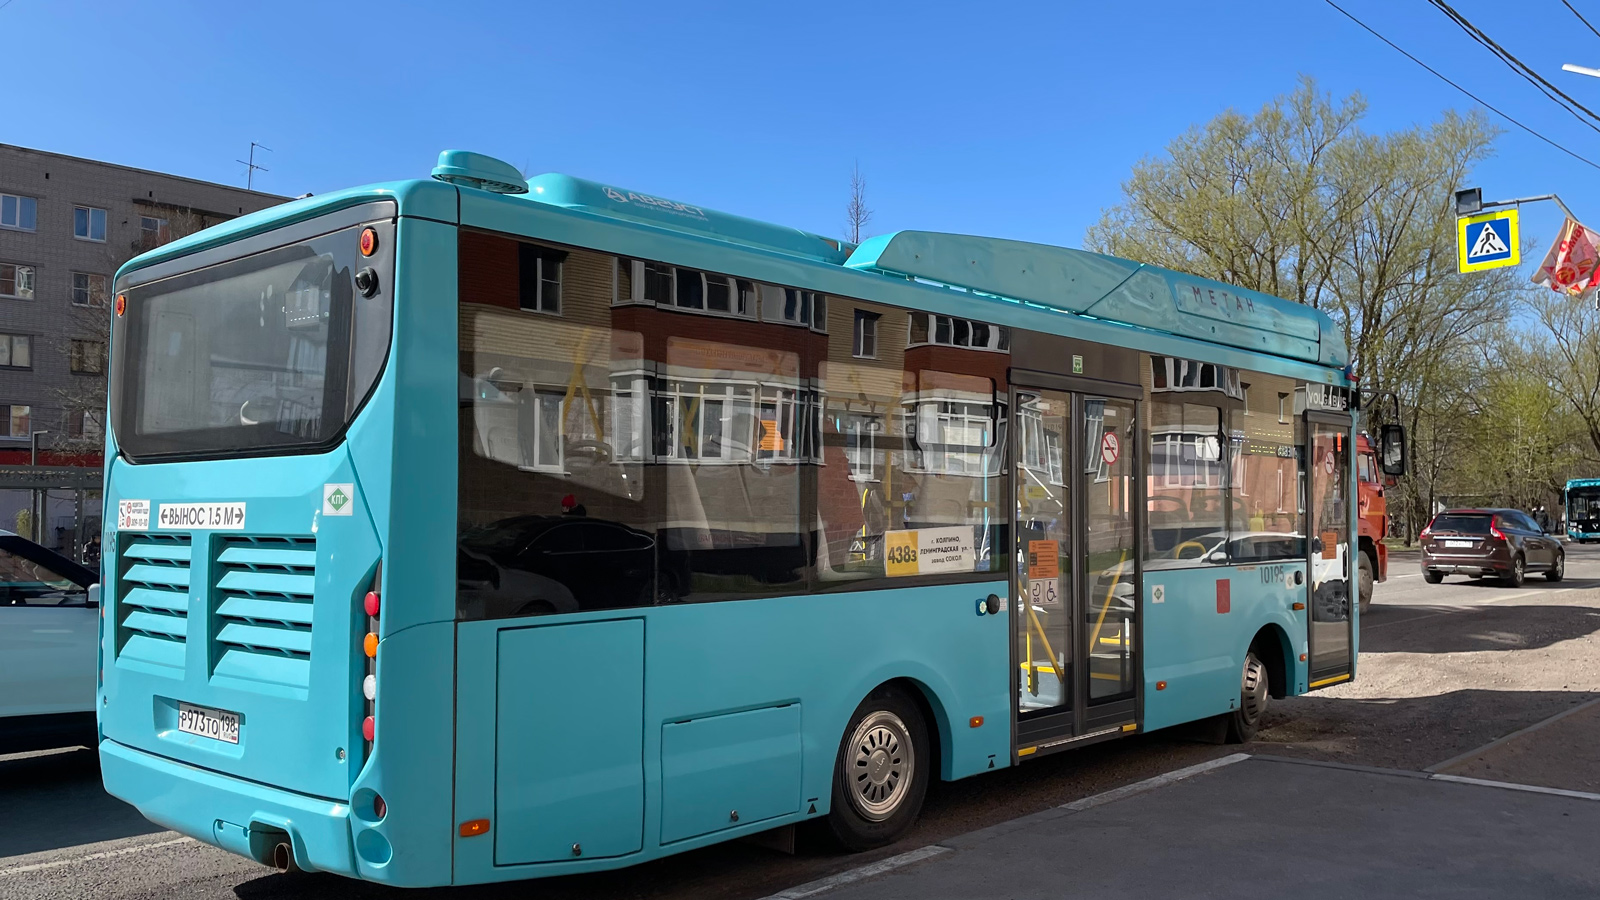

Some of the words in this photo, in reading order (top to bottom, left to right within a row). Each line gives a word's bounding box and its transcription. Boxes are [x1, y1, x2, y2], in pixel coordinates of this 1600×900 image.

[1191, 286, 1256, 313] МЕТАН
[331, 494, 345, 505] КПГ
[168, 507, 205, 526] ВЫНОС
[208, 507, 221, 526] 1.5
[223, 507, 234, 526] М
[919, 545, 959, 555] ЛЕНИНГРАДСКАЯ
[1259, 565, 1285, 584] 10195
[179, 709, 219, 736] Р973ТО
[220, 714, 236, 733] 198
